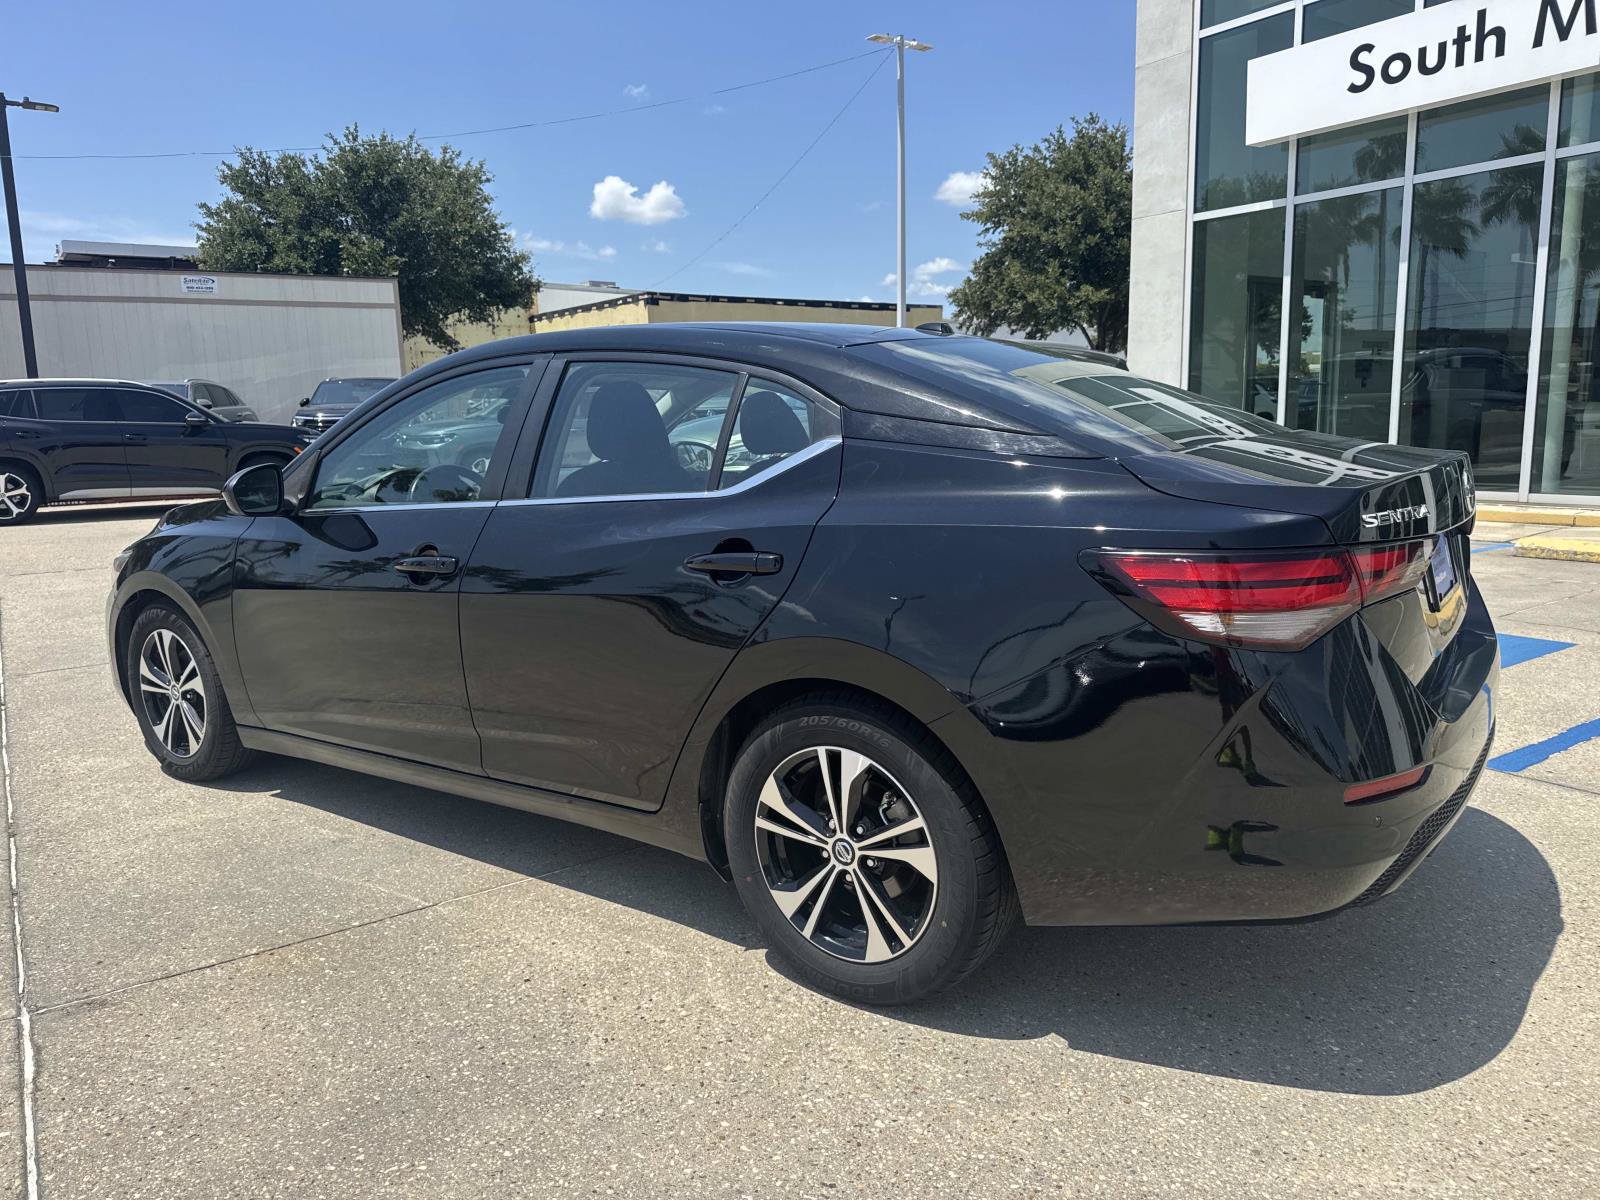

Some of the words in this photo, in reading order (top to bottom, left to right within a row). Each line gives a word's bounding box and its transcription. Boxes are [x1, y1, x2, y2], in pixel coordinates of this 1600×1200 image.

[1346, 8, 1507, 94] South
[1532, 0, 1599, 50] M
[1361, 504, 1432, 528] SENTRA
[799, 715, 891, 748] 205/60R16
